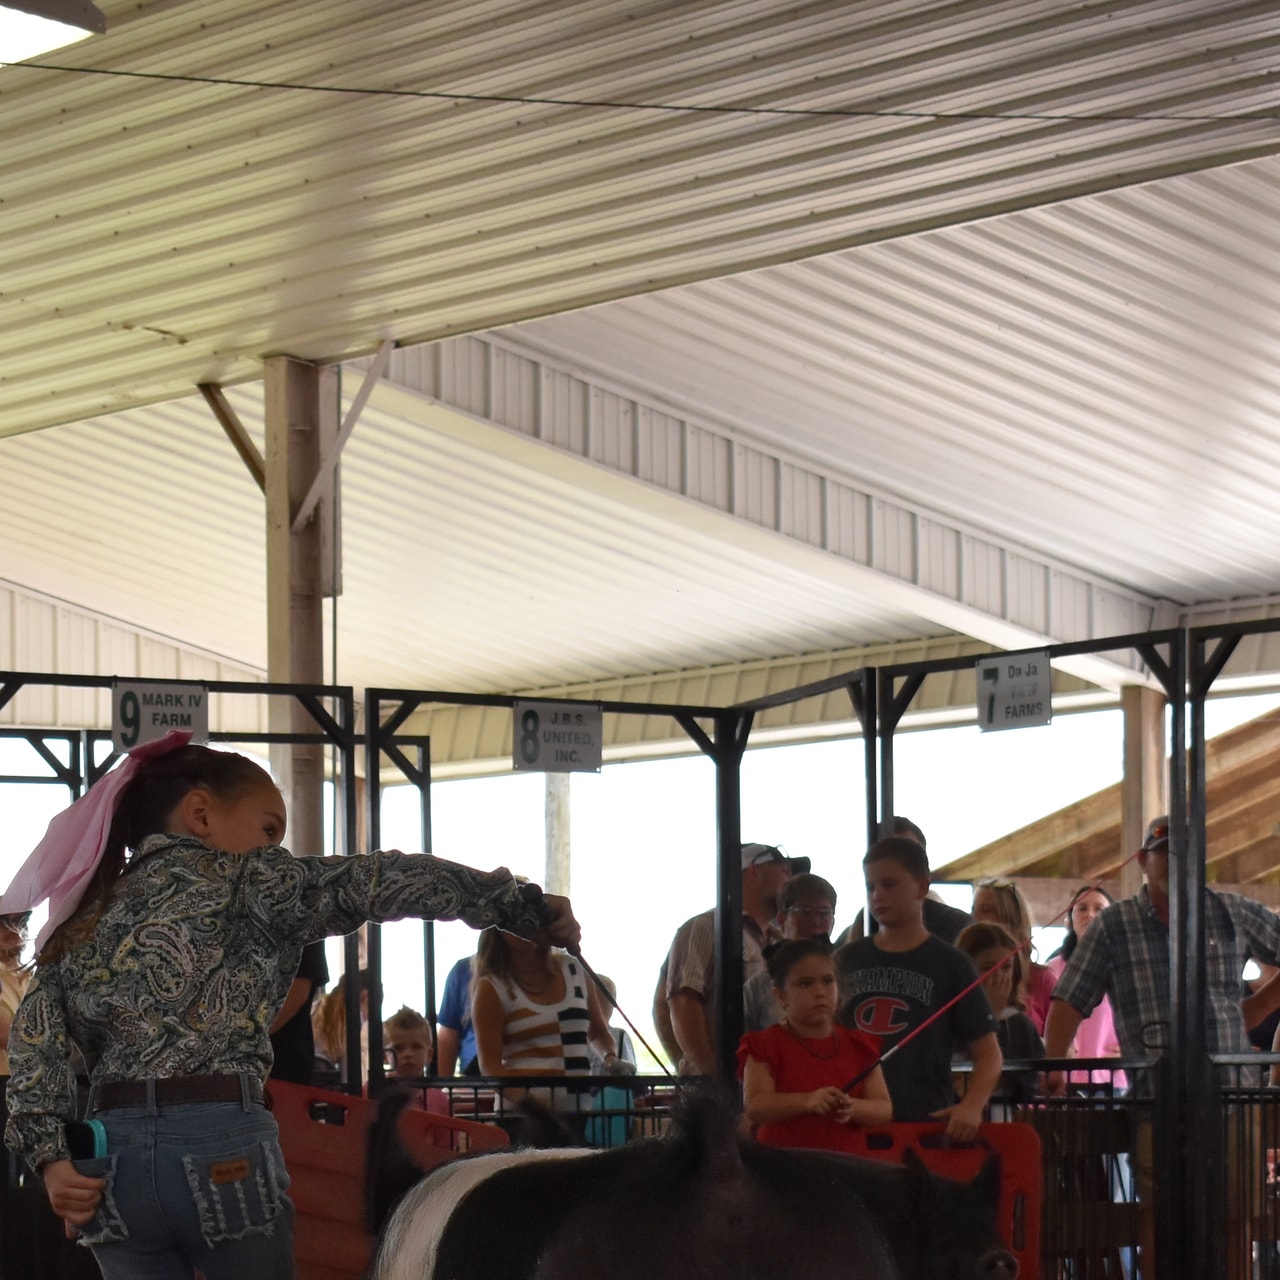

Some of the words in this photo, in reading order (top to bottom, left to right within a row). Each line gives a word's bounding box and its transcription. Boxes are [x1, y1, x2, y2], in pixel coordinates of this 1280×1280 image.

[142, 693, 185, 707] MARK
[188, 695, 202, 708] IV
[983, 667, 999, 724] 7
[1005, 701, 1043, 719] FARMS
[121, 690, 140, 748] 9
[152, 713, 192, 727] FARM
[522, 709, 539, 764] 8
[543, 730, 594, 747] UNITED,
[555, 750, 582, 763] INC.
